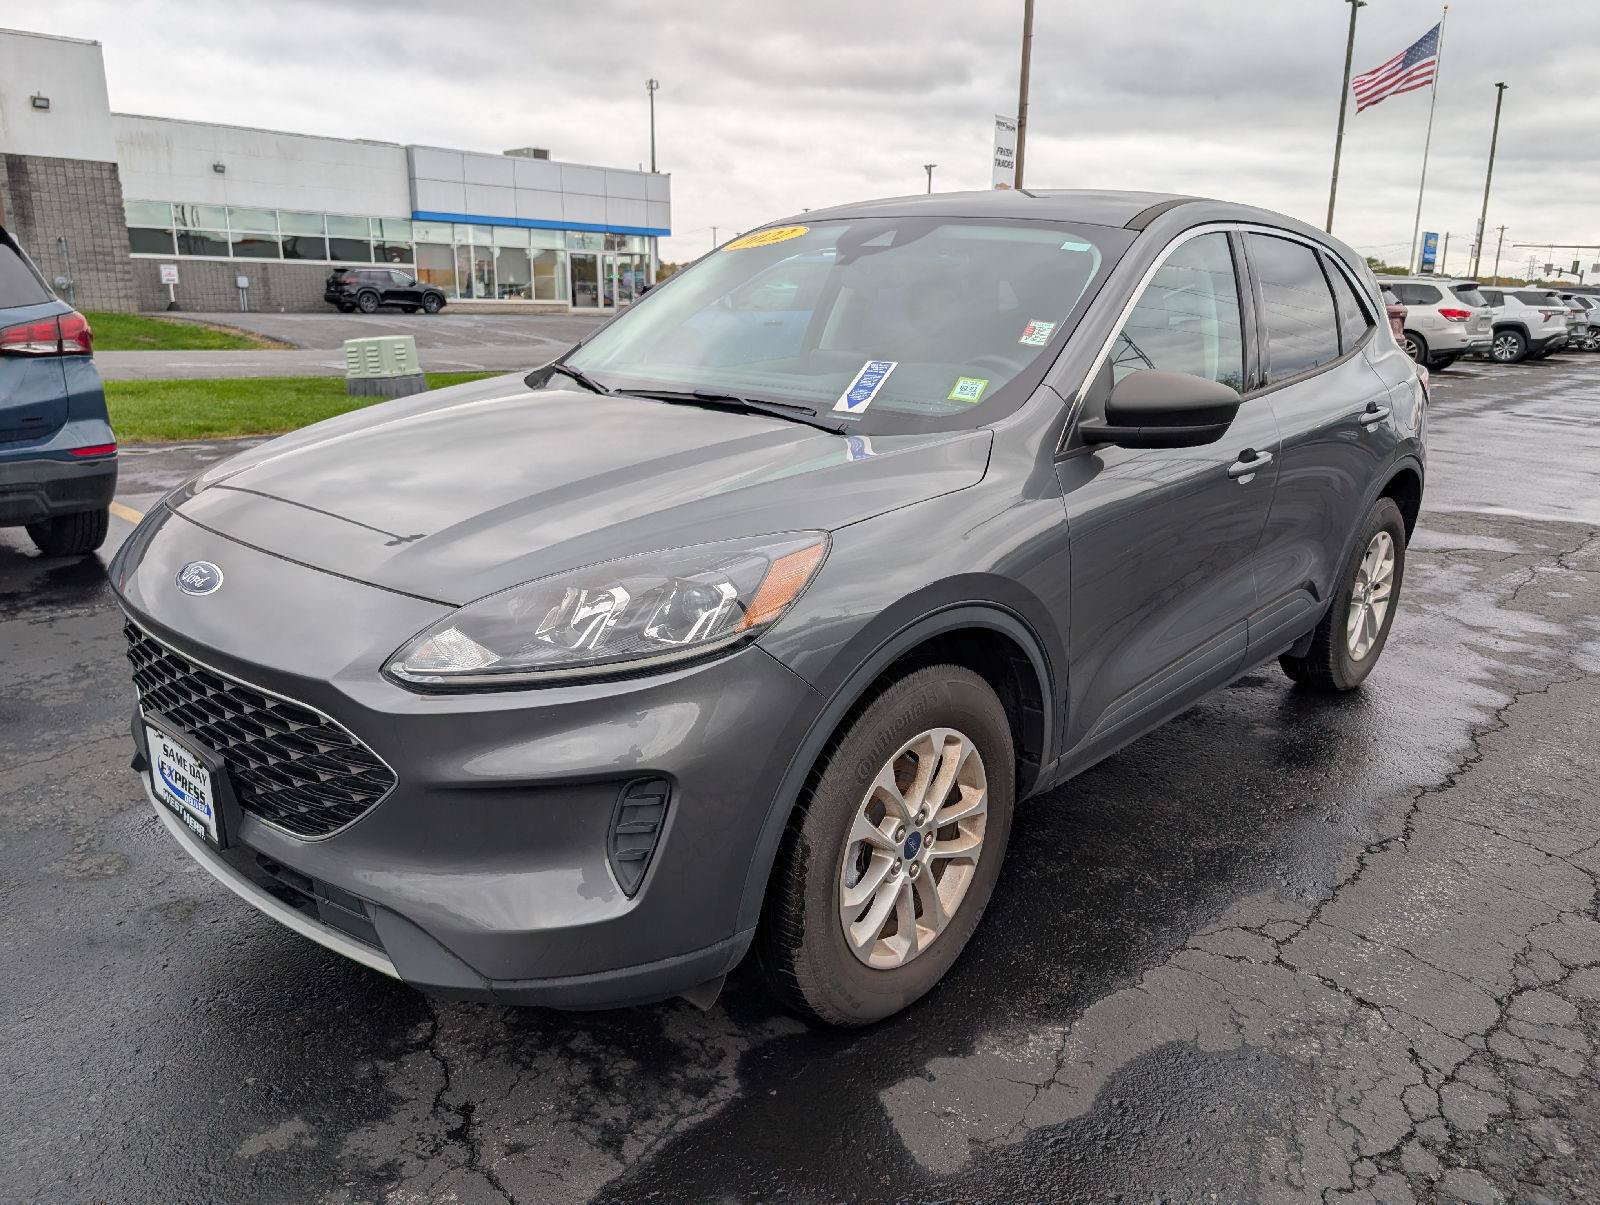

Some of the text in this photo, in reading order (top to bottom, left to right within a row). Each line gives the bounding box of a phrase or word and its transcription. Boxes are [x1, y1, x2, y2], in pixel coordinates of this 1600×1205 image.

[994, 158, 1014, 169] TRADES
[181, 565, 211, 588] Ford
[162, 743, 207, 787] SAME DAY
[160, 760, 206, 806] EXPRESS
[163, 788, 184, 815] WEST
